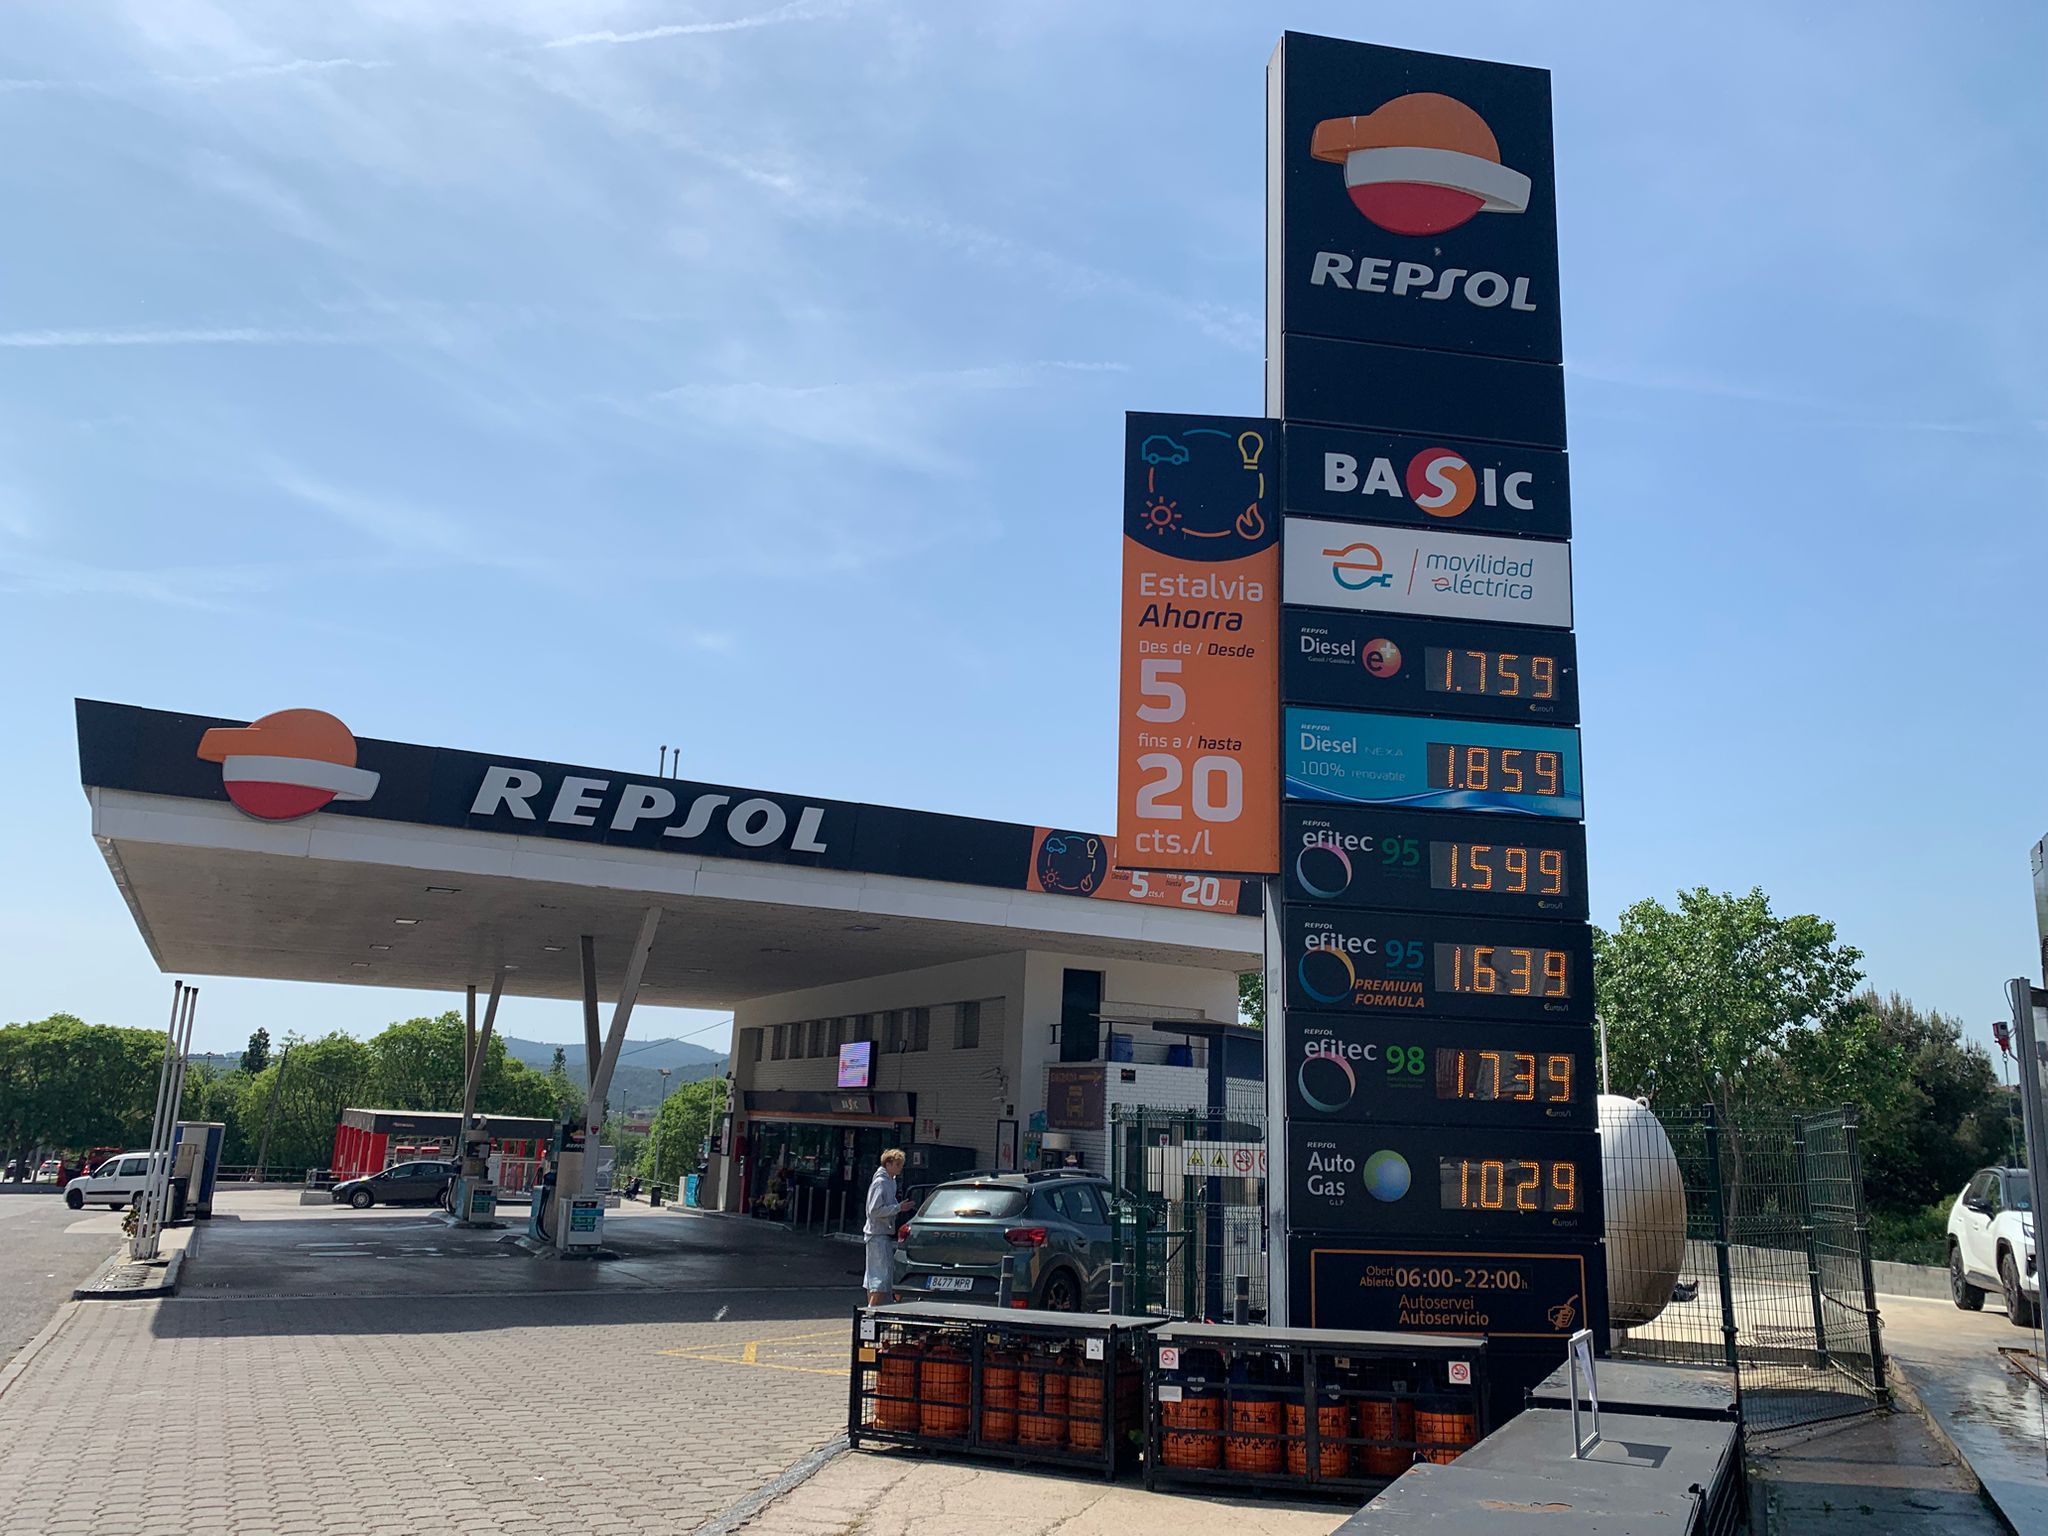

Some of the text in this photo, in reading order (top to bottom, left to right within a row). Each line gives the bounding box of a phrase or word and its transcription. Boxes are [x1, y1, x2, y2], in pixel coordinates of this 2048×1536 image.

[1310, 251, 1537, 312] REPSOL
[1324, 452, 1535, 510] BASIC
[1426, 553, 1534, 578] movilidad
[1140, 572, 1264, 602] Estalvia
[1432, 574, 1533, 600] eléctrica
[1138, 602, 1243, 631] Ahorra
[1301, 627, 1328, 635] REPSOL
[1139, 640, 1255, 658] Des de / Desde
[1300, 635, 1356, 657] Diesel
[1446, 649, 1554, 698] 1.759
[1136, 658, 1187, 723] 5
[1301, 723, 1331, 732] REPSOL
[1138, 732, 1242, 751] fins a / hasta
[1300, 732, 1404, 757] Diesel NEXA
[1301, 760, 1406, 782] 100% renovable
[1448, 746, 1557, 795] 1.859
[1136, 753, 1243, 823] 20
[470, 765, 828, 853] REPSOL
[1302, 820, 1331, 828] REPSOL
[1136, 829, 1213, 856] cts./l
[1302, 829, 1421, 867] efitec 95
[1451, 844, 1562, 894] 1.599
[1129, 871, 1149, 898] 5
[1181, 875, 1220, 906] 20
[1304, 922, 1334, 930] REPSOL
[1305, 932, 1424, 970] efitec 95
[1454, 947, 1566, 998] 1.639
[1354, 979, 1423, 994] PREMIUM
[1355, 993, 1425, 1009] FORMULA
[1304, 1028, 1334, 1036] REPSOL
[1304, 1039, 1426, 1075] efitec 98
[1457, 1052, 1570, 1102] 1.739
[1307, 1141, 1337, 1149] REPSOL
[1307, 1151, 1356, 1173] Auto
[1307, 1175, 1346, 1197] Gas
[1460, 1159, 1576, 1211] 1.029
[932, 1277, 971, 1289] 8477 MPR
[1359, 1276, 1395, 1287] Abierto
[1366, 1265, 1394, 1276] Obert
[1399, 1294, 1474, 1310] Autoservei
[1399, 1310, 1489, 1327] Autoservicio
